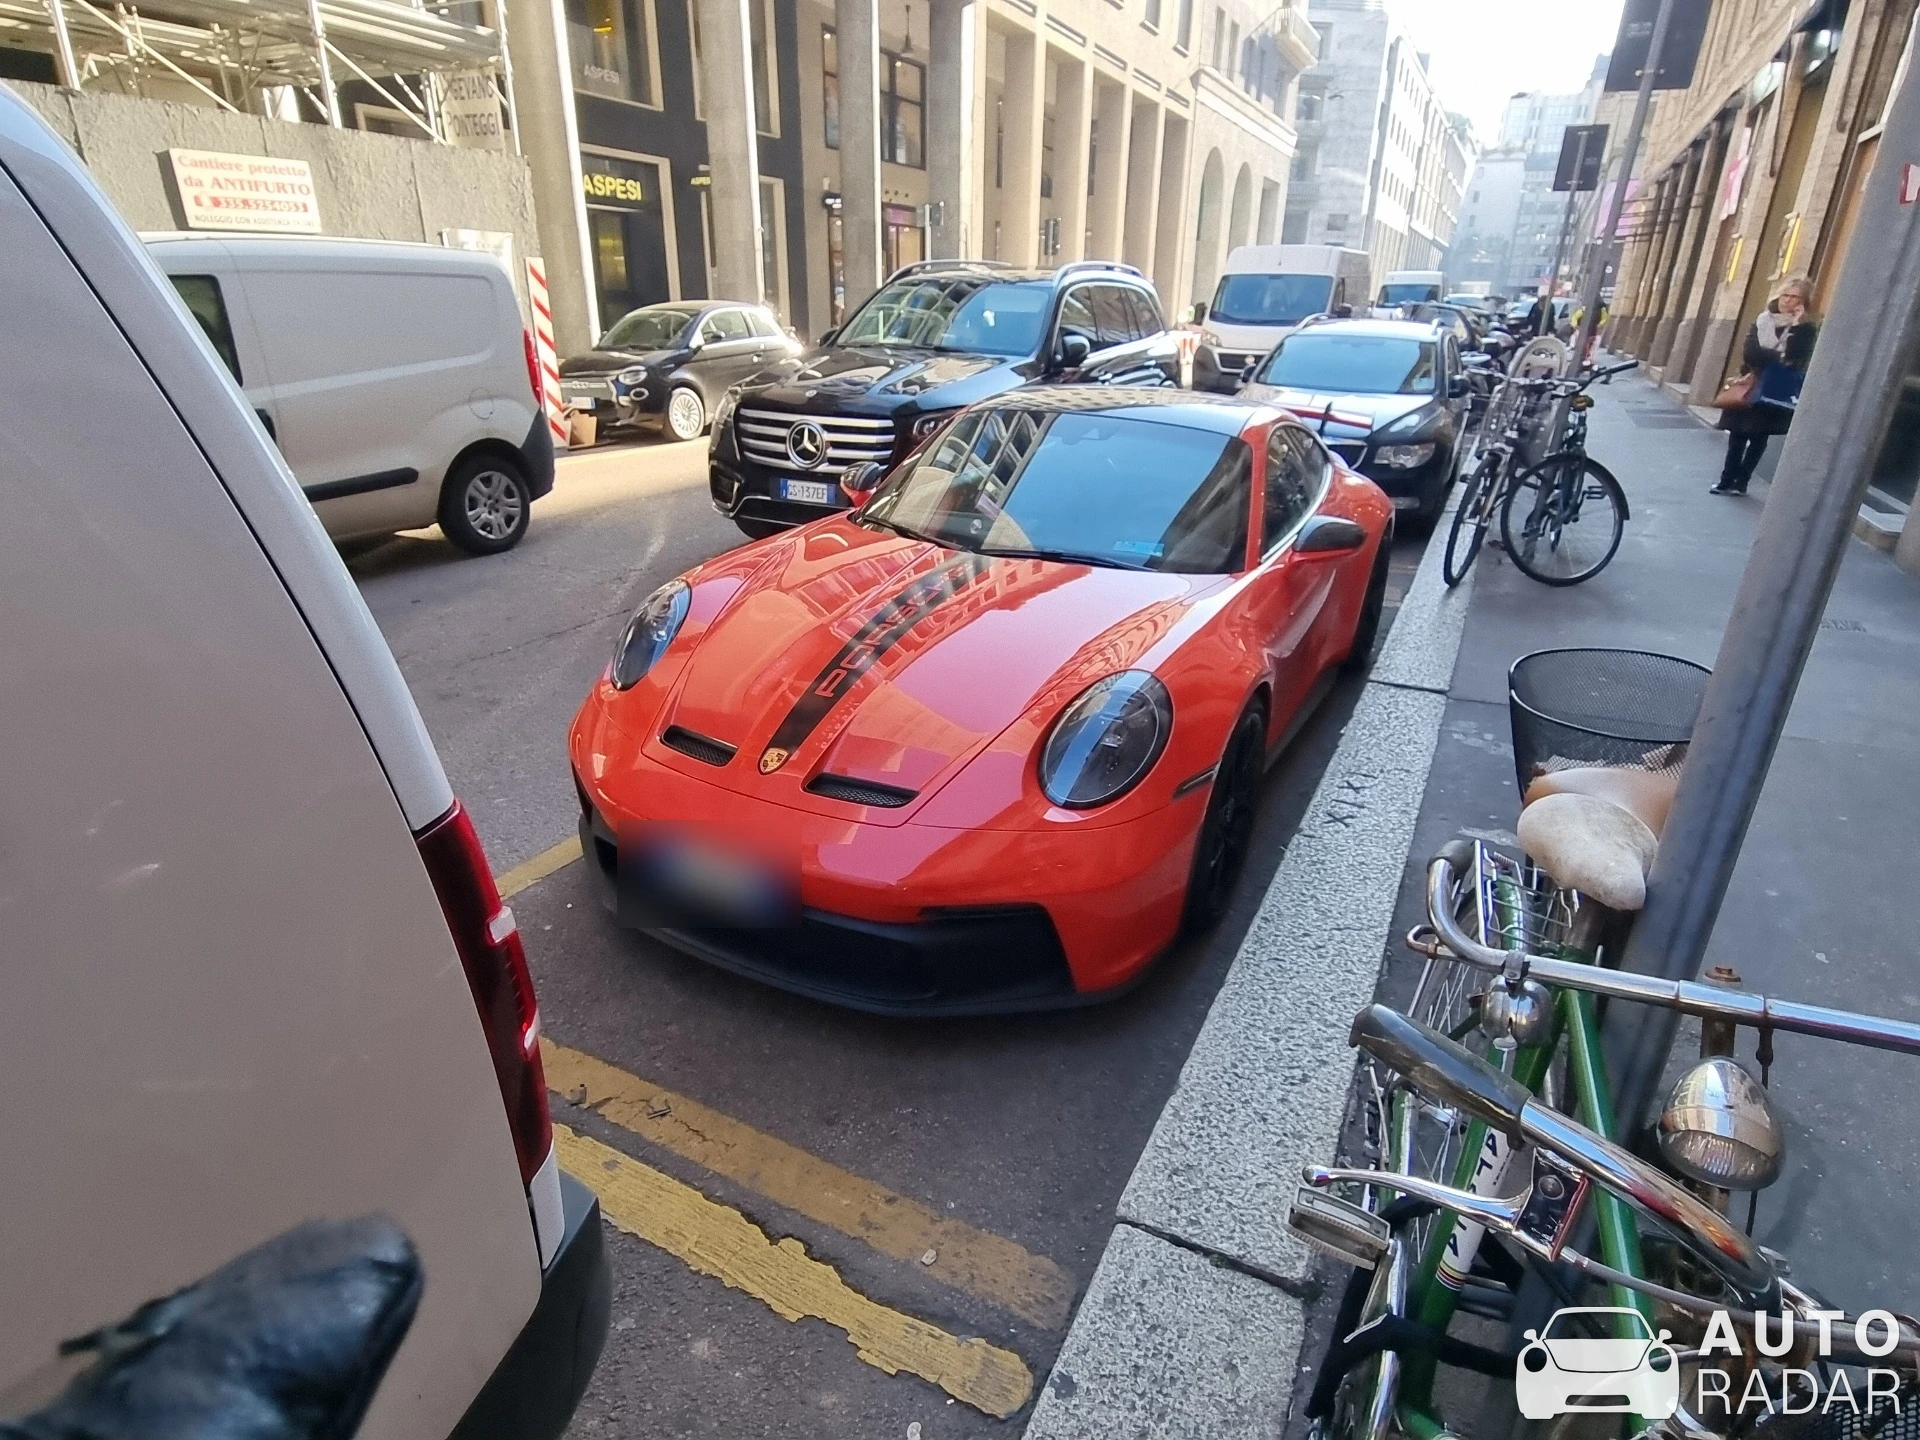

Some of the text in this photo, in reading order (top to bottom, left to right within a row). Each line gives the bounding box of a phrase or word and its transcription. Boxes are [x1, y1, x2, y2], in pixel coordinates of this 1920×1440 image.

[584, 65, 619, 83] ASPESI
[178, 156, 306, 177] Cantiere protetto
[183, 175, 311, 196] da ANTIFURTO
[583, 174, 642, 201] ASPESI
[691, 176, 711, 186] ASPES
[815, 561, 976, 698] PORSCHE
